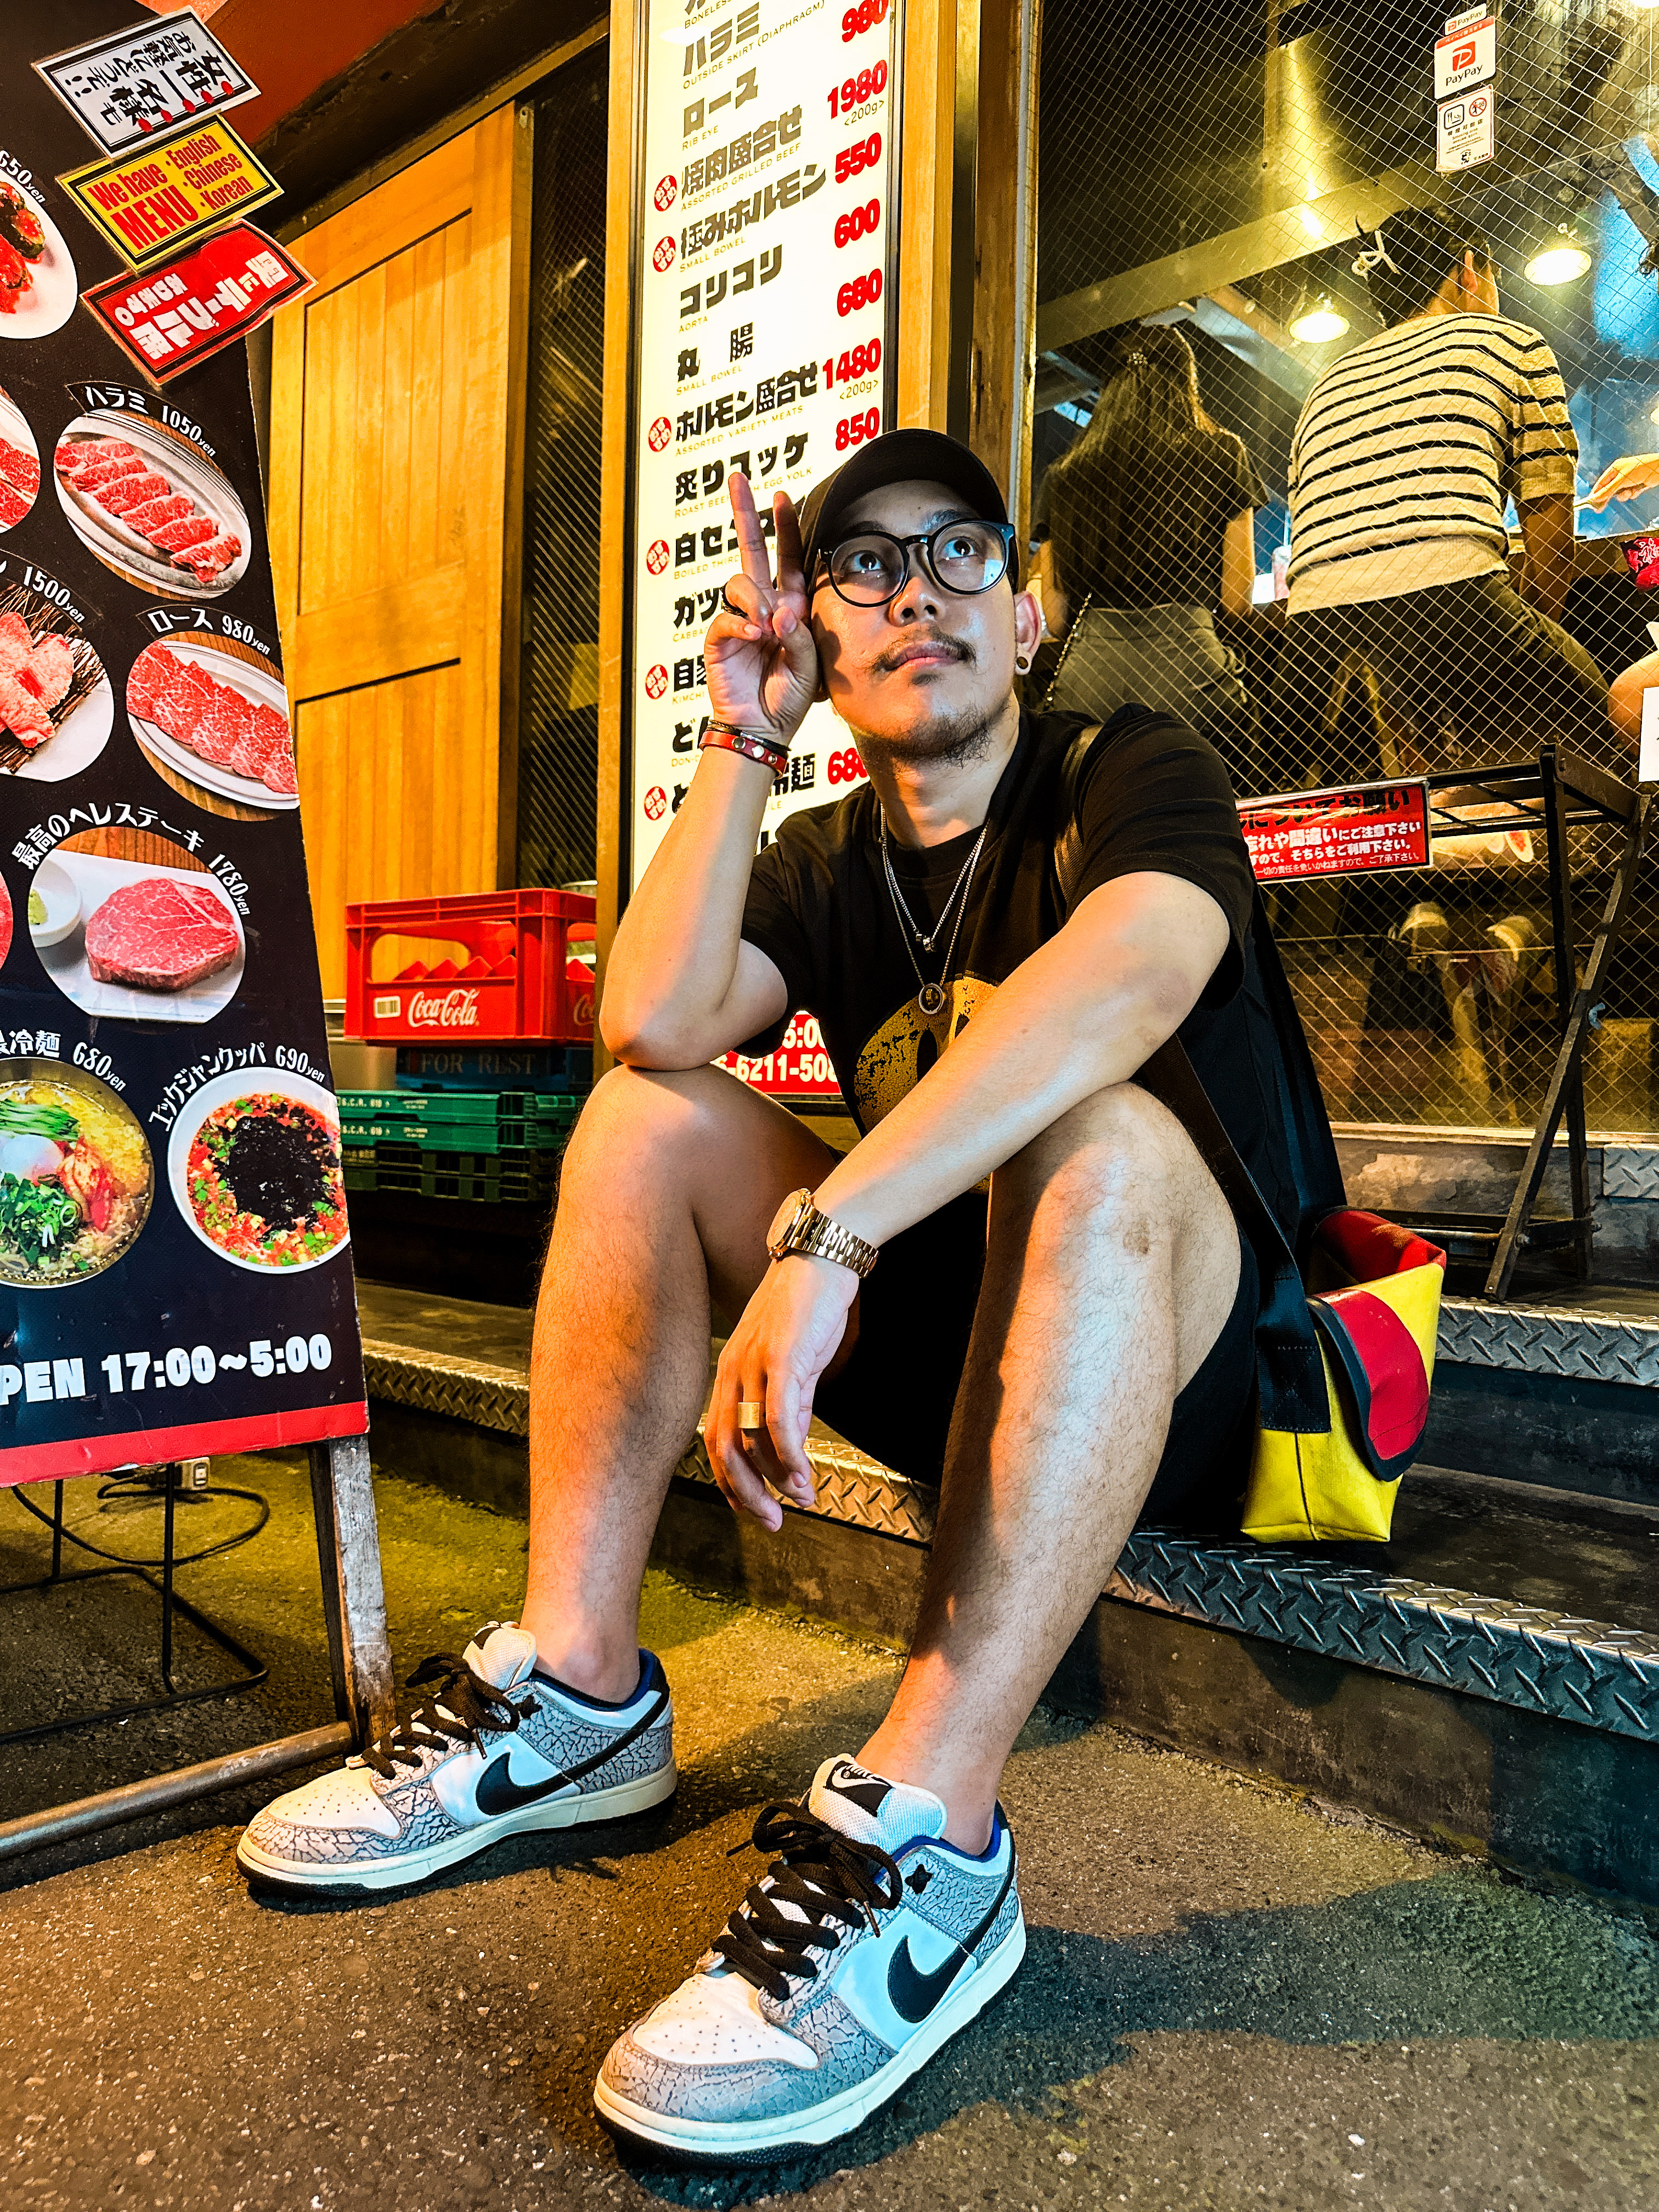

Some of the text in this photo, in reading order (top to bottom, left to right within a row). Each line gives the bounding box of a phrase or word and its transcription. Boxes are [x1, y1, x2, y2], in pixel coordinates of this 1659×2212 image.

[683, 0, 889, 76] ハラミ 980
[1458, 11, 1482, 25] PayPay
[683, 2, 825, 89] OUTSIDE SKIRT (DIAPHRAGM)
[100, 50, 231, 126] 女性一名様も
[684, 59, 888, 138] ロース 1980
[1445, 64, 1483, 86] PayPay
[682, 125, 719, 151] RIB EYE
[844, 100, 884, 126] <200g>
[166, 133, 222, 171] English
[184, 153, 242, 190] Chinese
[681, 104, 882, 200] 焼肉盛合せ 550
[87, 163, 168, 211] We have
[200, 175, 254, 211] Korean
[681, 143, 801, 212] ASSORTED GRILLED BEEF
[110, 184, 199, 250] MENU
[834, 198, 881, 248] 600
[680, 236, 746, 273] SMALL BOWEL
[129, 250, 289, 360] 奥にテーブル席
[680, 244, 782, 319] コリコリ
[679, 316, 708, 334] AORTA
[676, 365, 743, 396] SMALL BOWEL
[676, 338, 882, 442] ホルモン盛合せ 1480
[839, 380, 878, 400] <200g>
[84, 386, 216, 458] ハラミ 1050yen
[675, 405, 803, 457] ASSORTED VARIETY MEATS
[836, 407, 879, 451] 850
[675, 503, 704, 518] ROAST
[764, 477, 783, 489] EGG
[787, 467, 812, 482] YOLK
[24, 566, 85, 623] 1500yen
[674, 564, 708, 580] BOILED
[148, 608, 271, 655] ロース 980yen
[12, 803, 251, 916] 最高のヘレステーキ 1780yen
[408, 989, 480, 1028] Coca-Cola
[73, 1042, 126, 1092] 680yen
[149, 1042, 325, 1131] ユッケジャンクッパ 690yen
